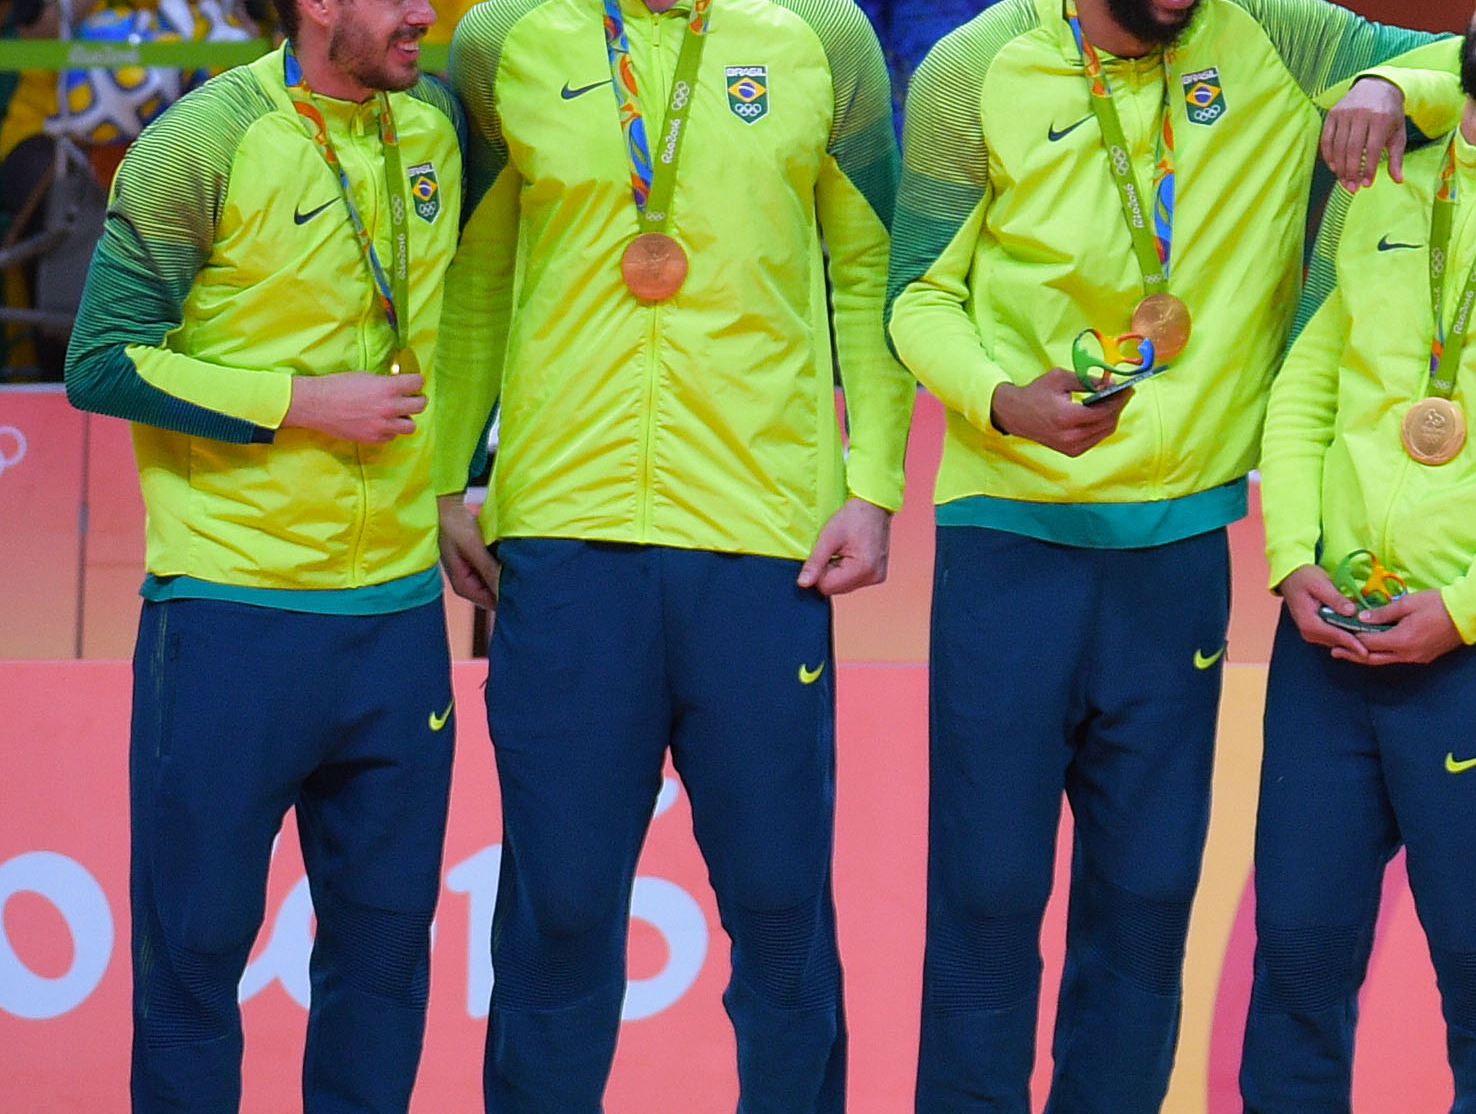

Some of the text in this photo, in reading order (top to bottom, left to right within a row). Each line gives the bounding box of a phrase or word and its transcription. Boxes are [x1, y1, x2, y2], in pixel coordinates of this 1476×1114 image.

[726, 67, 766, 77] BRASIL
[1182, 69, 1218, 84] BRASIL
[661, 118, 681, 164] Rio2016
[1123, 183, 1144, 228] Rio2016
[1453, 290, 1474, 335] Rio2016
